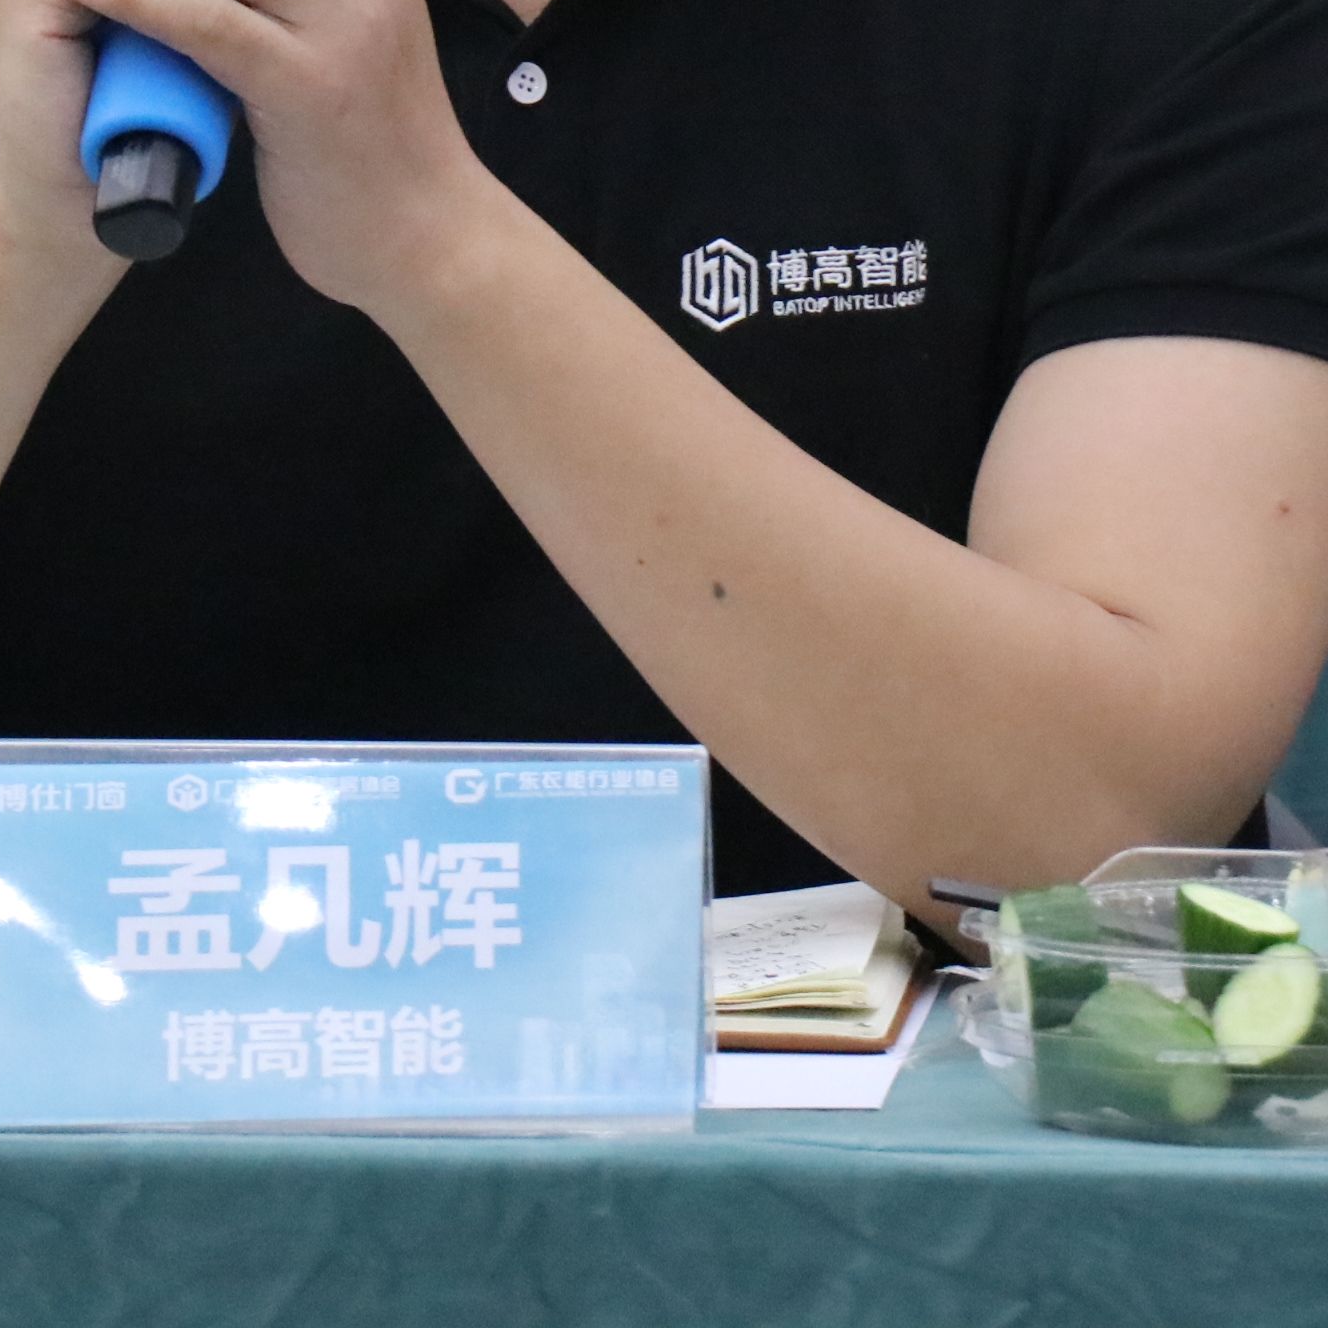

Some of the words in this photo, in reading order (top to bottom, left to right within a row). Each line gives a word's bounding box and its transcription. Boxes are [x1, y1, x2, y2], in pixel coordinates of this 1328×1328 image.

[767, 239, 928, 295] 博高智能
[773, 294, 830, 317] BATOP
[107, 838, 522, 972] 孟凡辉
[161, 1004, 464, 1082] 博高智能
